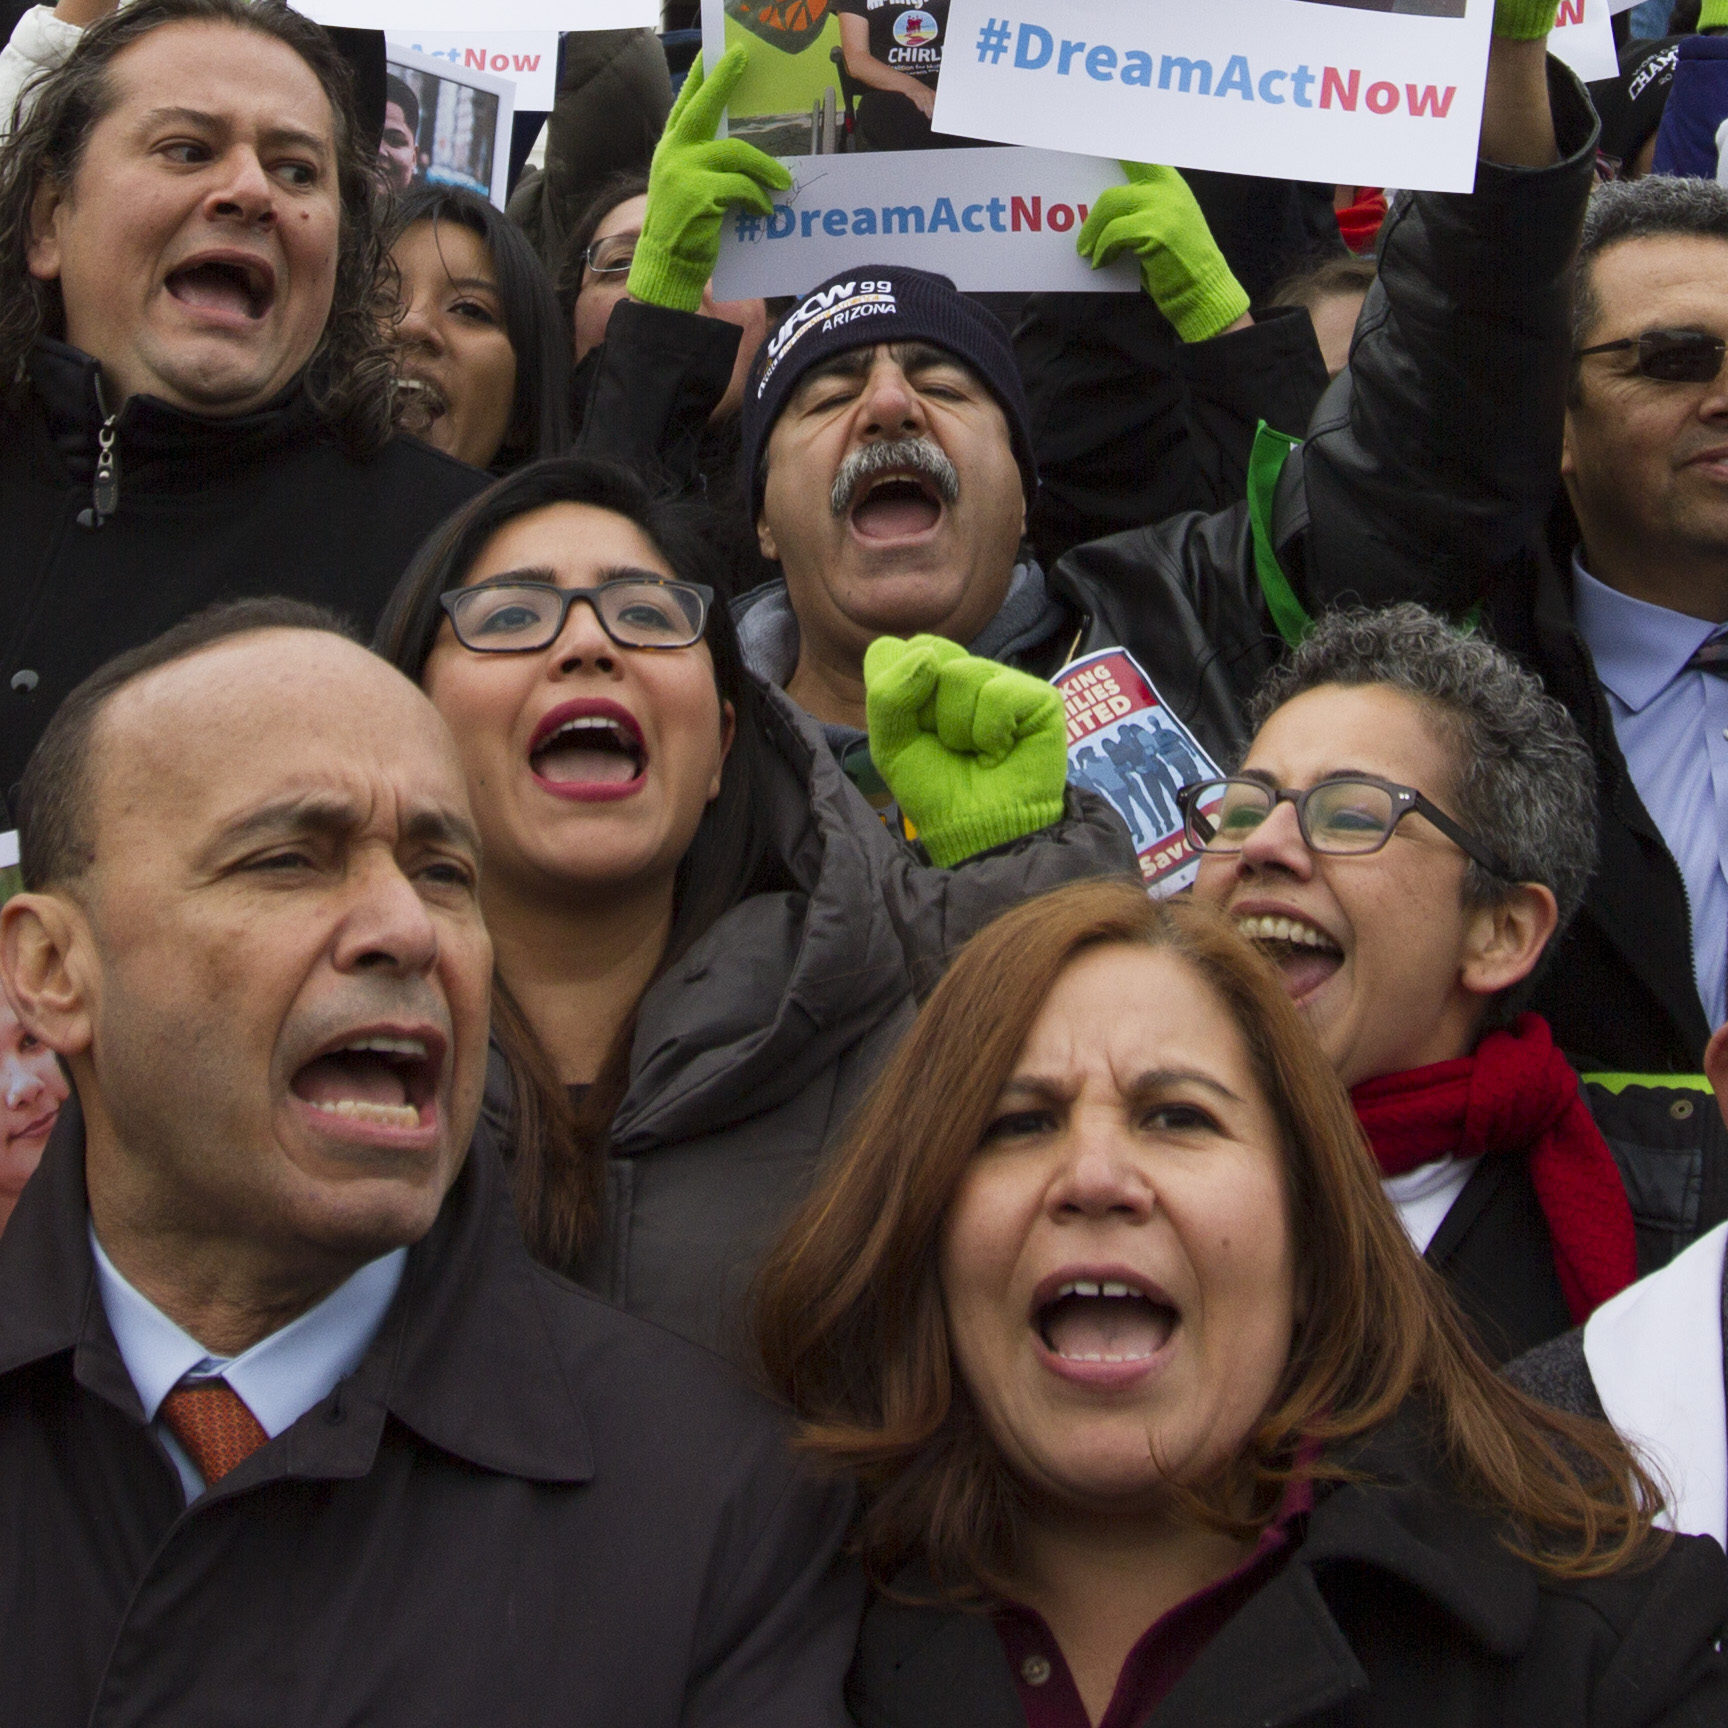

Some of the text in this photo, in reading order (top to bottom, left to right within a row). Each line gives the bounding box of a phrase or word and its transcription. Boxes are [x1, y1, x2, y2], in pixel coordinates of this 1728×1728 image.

[887, 45, 943, 64] CHIRL
[975, 17, 1458, 120] #DreamActNow
[767, 280, 892, 358] UFCW 99
[822, 303, 897, 333] ARIZONA
[1065, 678, 1122, 719] ILIES
[1067, 695, 1132, 747] ITED
